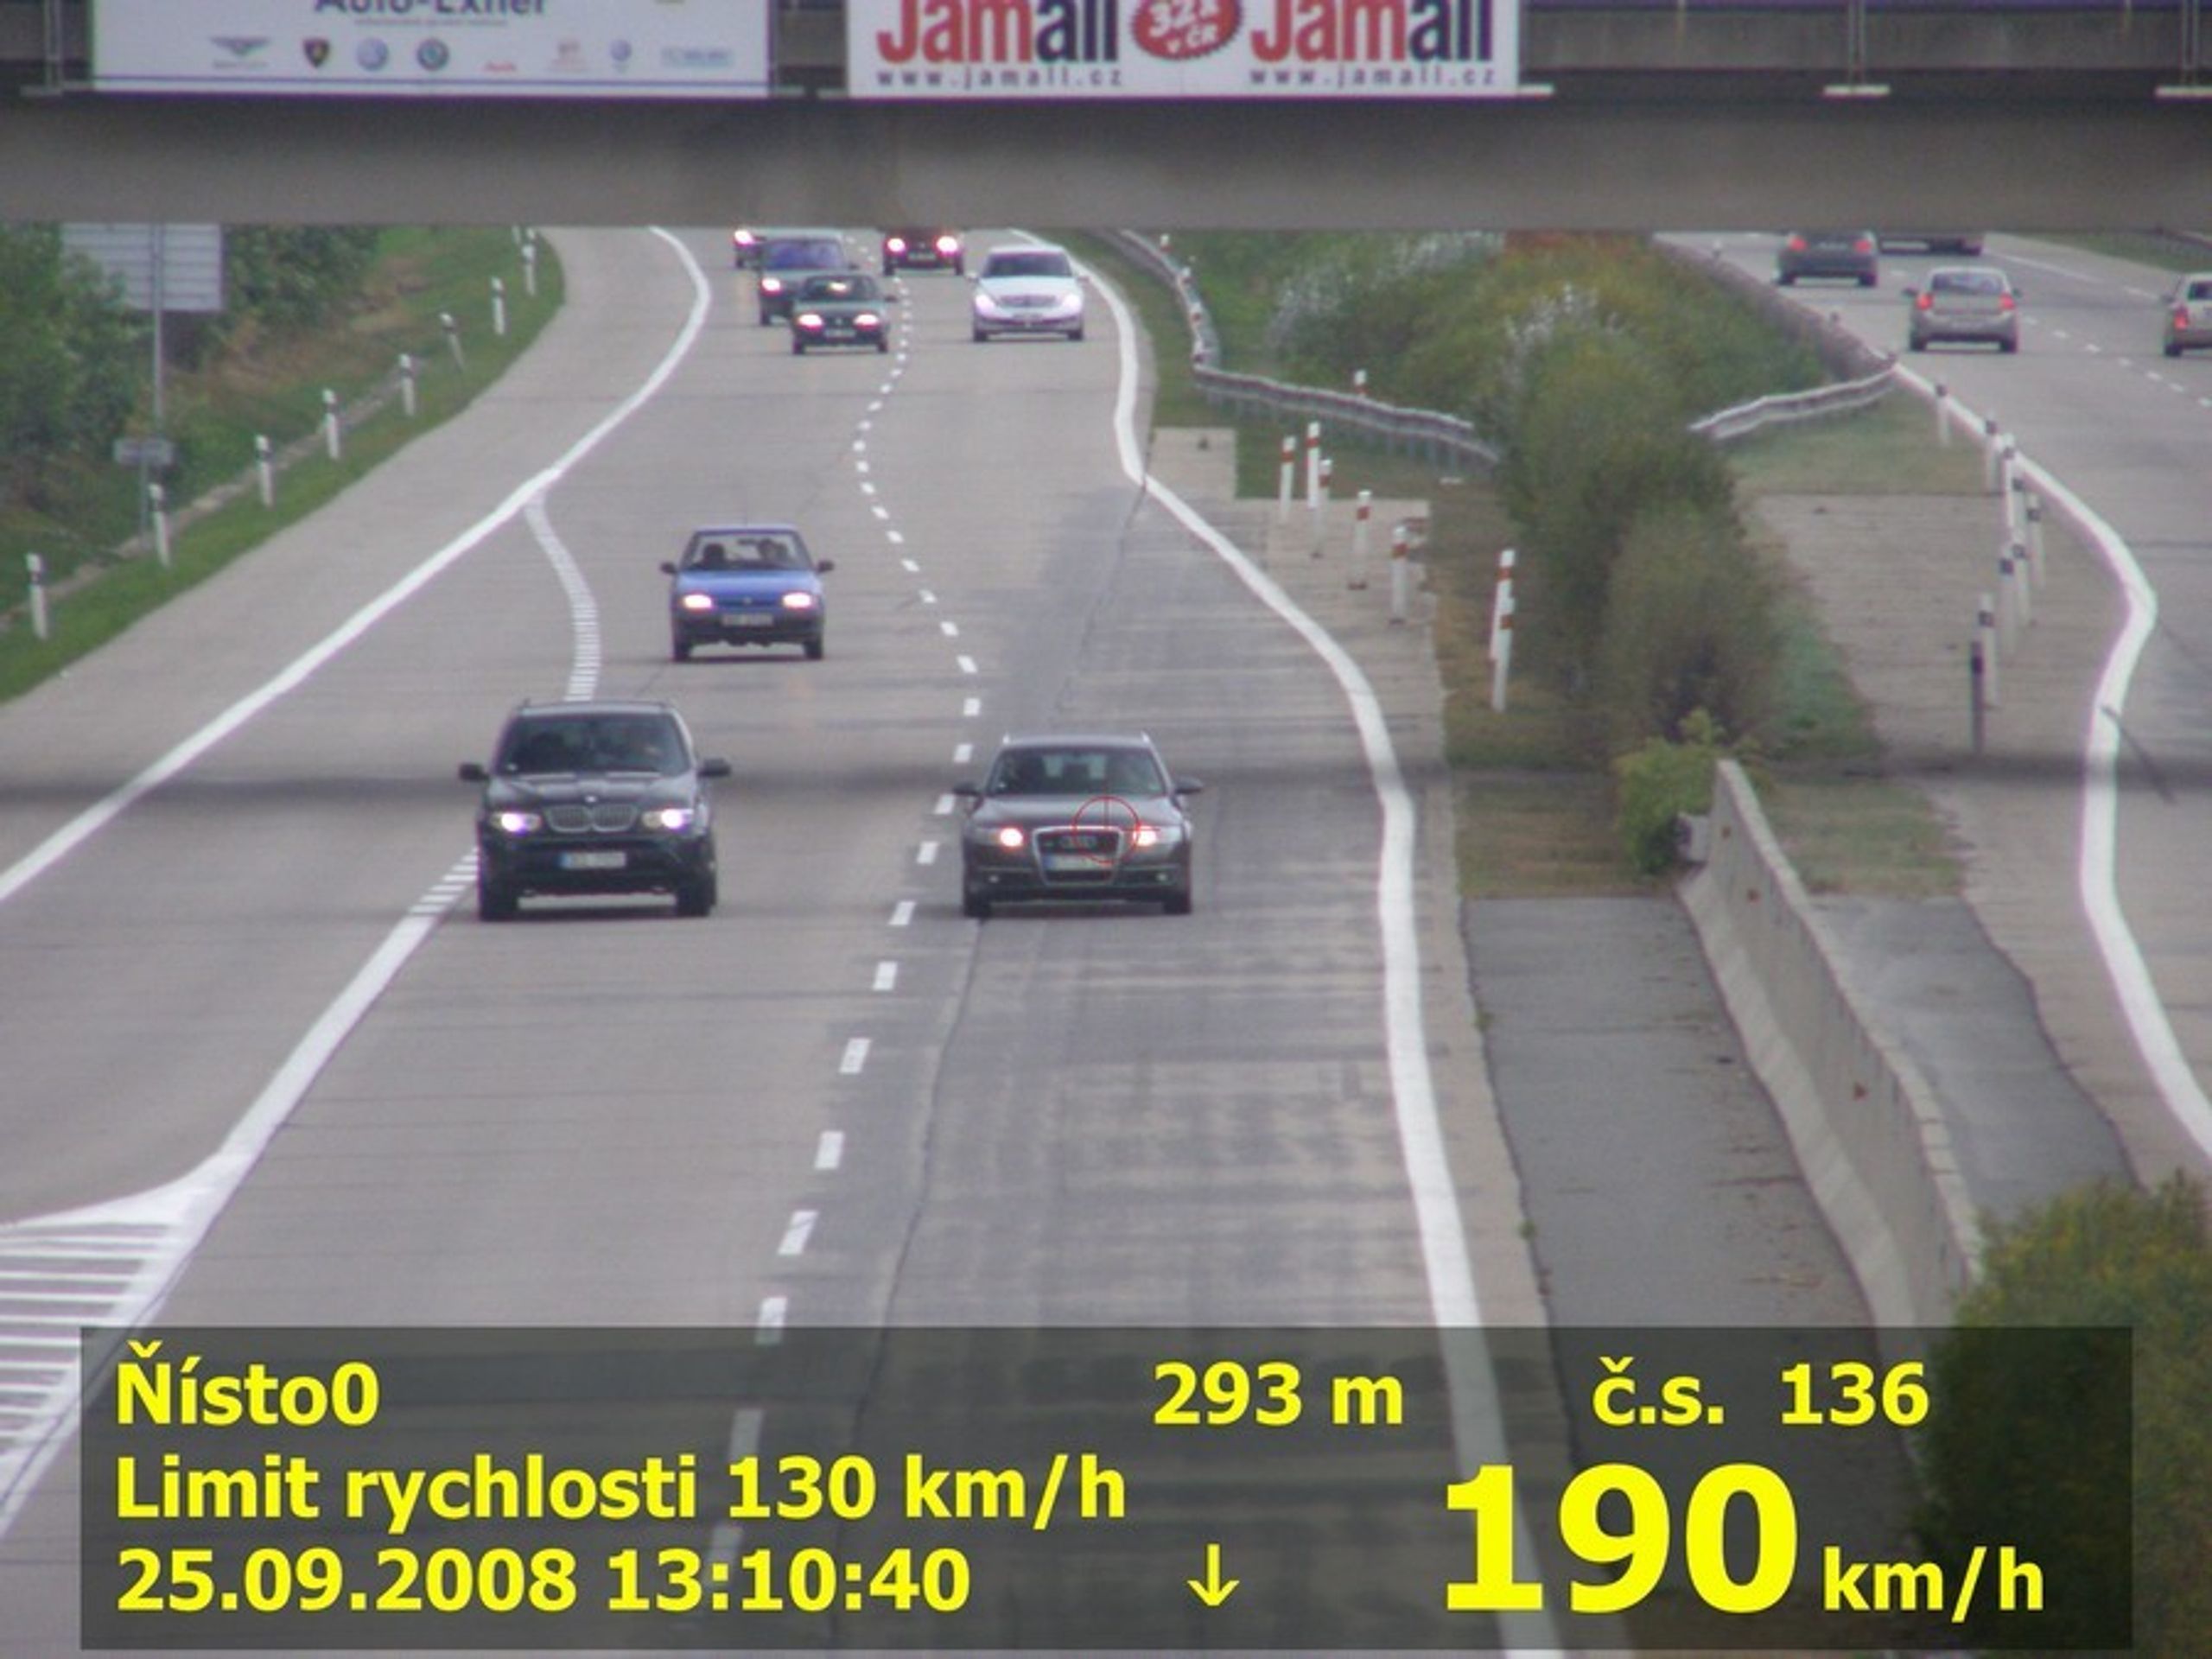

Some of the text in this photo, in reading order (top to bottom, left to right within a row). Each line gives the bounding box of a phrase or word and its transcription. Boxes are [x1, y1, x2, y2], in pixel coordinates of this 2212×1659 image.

[876, 0, 1119, 63] Jamall
[1249, 0, 1493, 62] Jamall
[877, 67, 1122, 90] www.jamall.cz
[1250, 65, 1494, 87] www.jamall.cz
